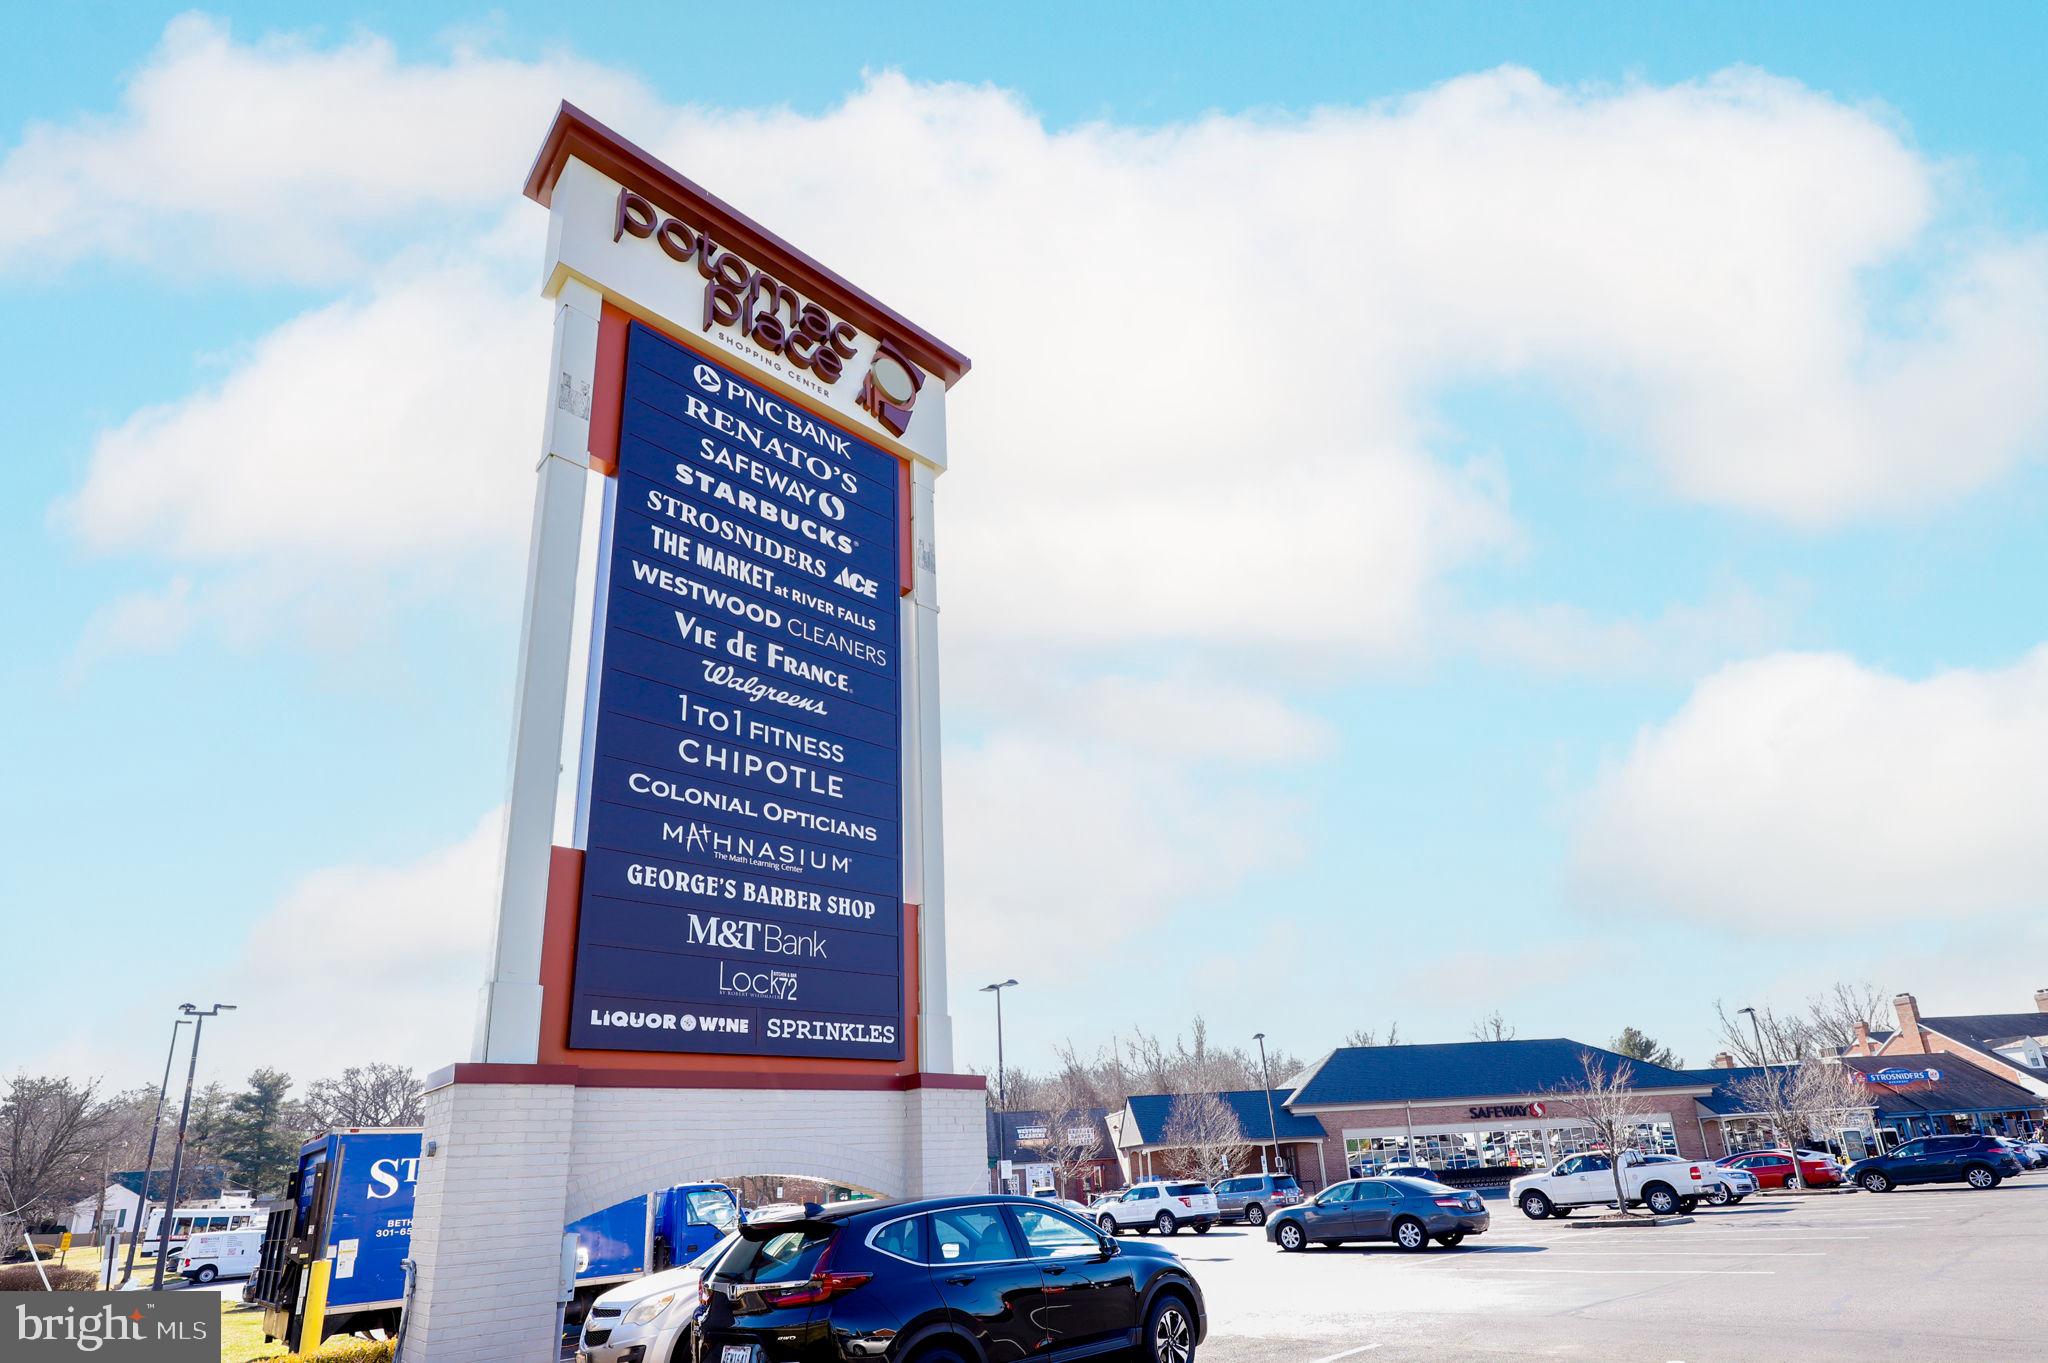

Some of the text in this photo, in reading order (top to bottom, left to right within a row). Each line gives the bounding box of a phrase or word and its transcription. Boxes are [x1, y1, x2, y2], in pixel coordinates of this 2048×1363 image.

[613, 188, 858, 360] potomac
[703, 279, 843, 384] place
[718, 331, 830, 399] SHOPPING CENTER
[685, 395, 857, 493] RENATO'S
[701, 439, 816, 505] SAFEWAY
[676, 464, 852, 553] STARBUCKS
[648, 491, 878, 598] STROSNIDERS ACE
[652, 525, 875, 630] THE MARKET at RIVER FALLS
[633, 560, 886, 666] WESTWOOD CLEANERS
[702, 660, 827, 715] Walgreens
[768, 643, 848, 691] FRANCE
[679, 739, 843, 798] CHIPOTLE
[751, 722, 843, 762] FITNESS
[629, 774, 876, 841] COLONIAL OPTICIANS
[628, 864, 875, 919] GEORGE'S BARBER SHOP
[714, 851, 803, 873] The Math Learning Center
[687, 914, 826, 958] M&T Bank
[767, 1019, 894, 1043] SPRINKLES
[1870, 1072, 1924, 1081] STROSNIDERS
[1469, 1105, 1528, 1119] SAFEWAY
